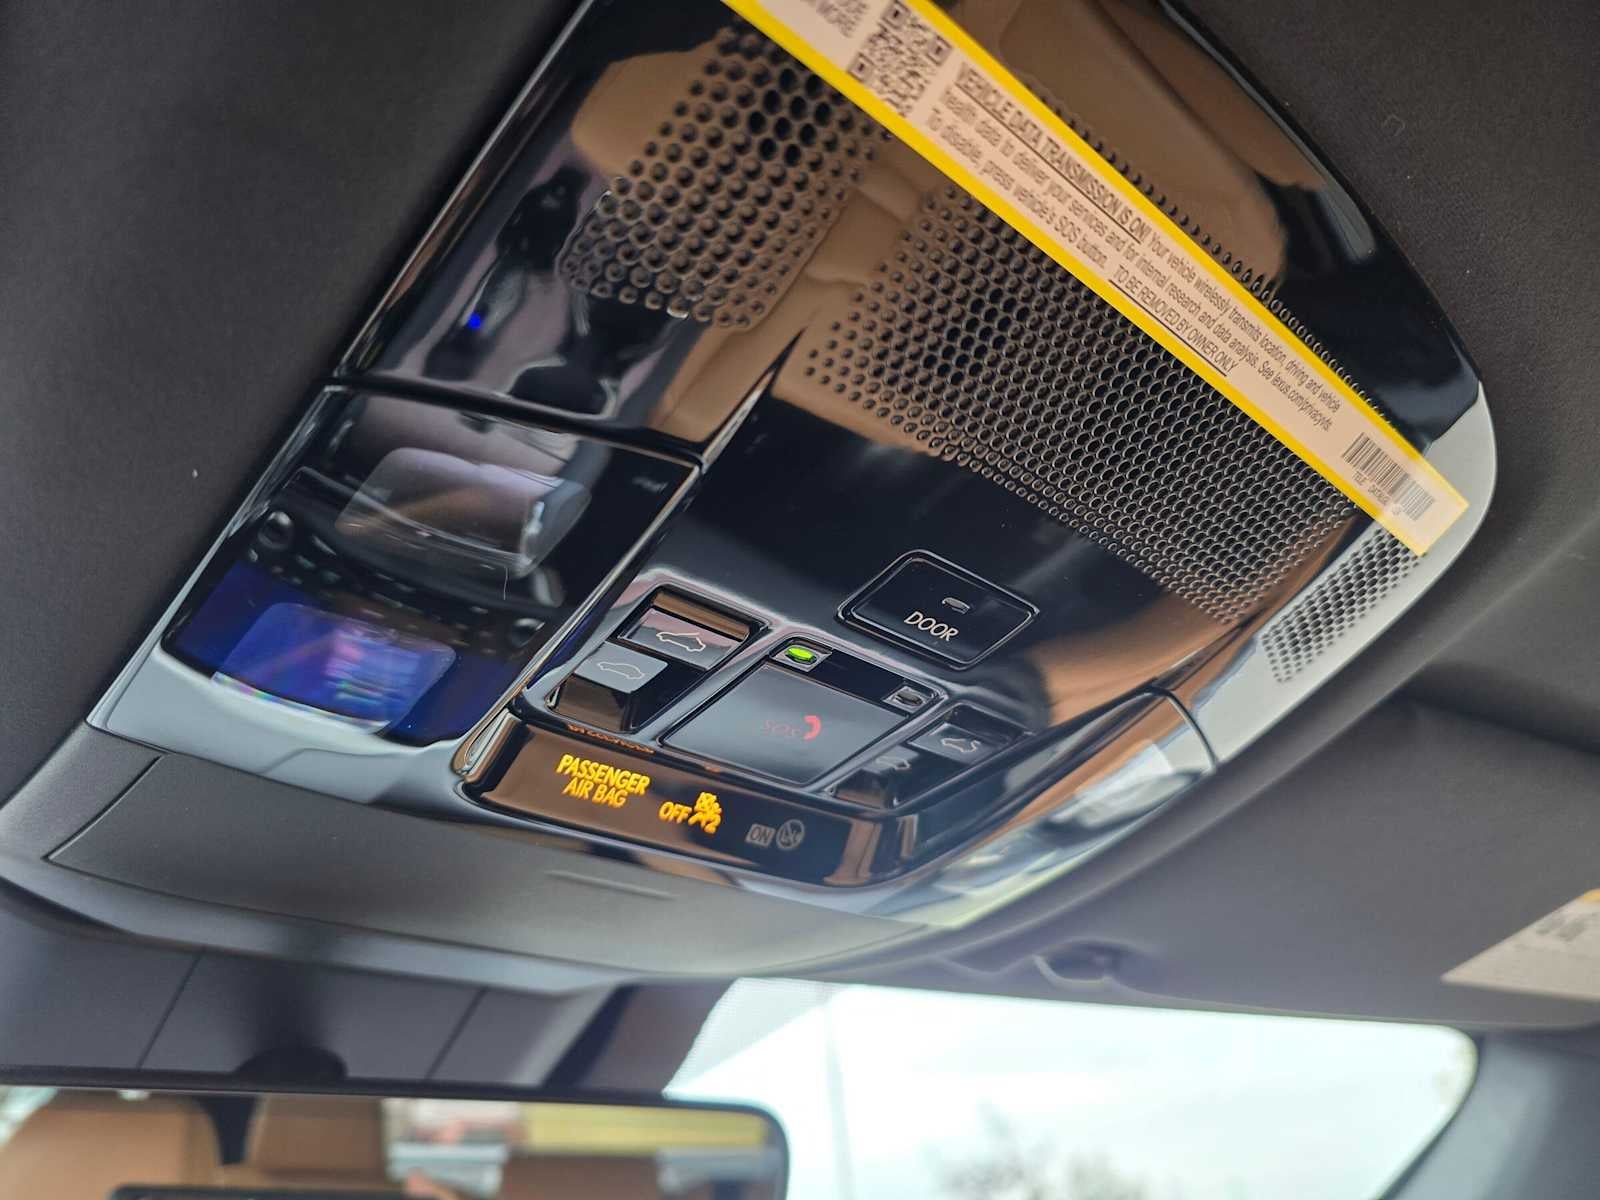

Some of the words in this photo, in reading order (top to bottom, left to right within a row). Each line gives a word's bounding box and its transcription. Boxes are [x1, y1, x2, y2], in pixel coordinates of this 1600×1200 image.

[954, 61, 1013, 121] VEHICLE
[1007, 107, 1044, 148] DATA
[1038, 135, 1122, 216] TRANSMISSION
[1116, 205, 1133, 226] IS
[1145, 232, 1171, 260] Your
[1165, 249, 1199, 284] vehicle
[1190, 273, 1234, 317] wirelessly
[1227, 305, 1265, 342] transmits
[1257, 332, 1290, 366] location,
[1282, 356, 1311, 386] driving
[1303, 374, 1323, 395] and
[979, 156, 1016, 195] press
[1053, 213, 1082, 245] SOS
[1112, 264, 1131, 285] TO
[1123, 273, 1143, 295] BE
[1136, 283, 1182, 328] REMOVED
[1174, 316, 1193, 337] BY
[1186, 326, 1220, 359] OWNER
[1212, 348, 1239, 375] ONLY
[1042, 177, 1073, 211] your
[1066, 194, 1111, 238] services
[1103, 226, 1128, 253] and
[1122, 241, 1142, 264] for
[1134, 251, 1169, 287] internal
[1164, 278, 1203, 317] research
[1196, 307, 1219, 330] and
[1211, 319, 1234, 344] data
[1225, 333, 1263, 371] analysis.
[1256, 359, 1276, 380] See
[904, 611, 959, 642] DOOR
[556, 753, 650, 796] PASSENGER
[562, 777, 595, 801] AIR
[591, 785, 629, 809] BAG
[658, 801, 692, 824] OFF
